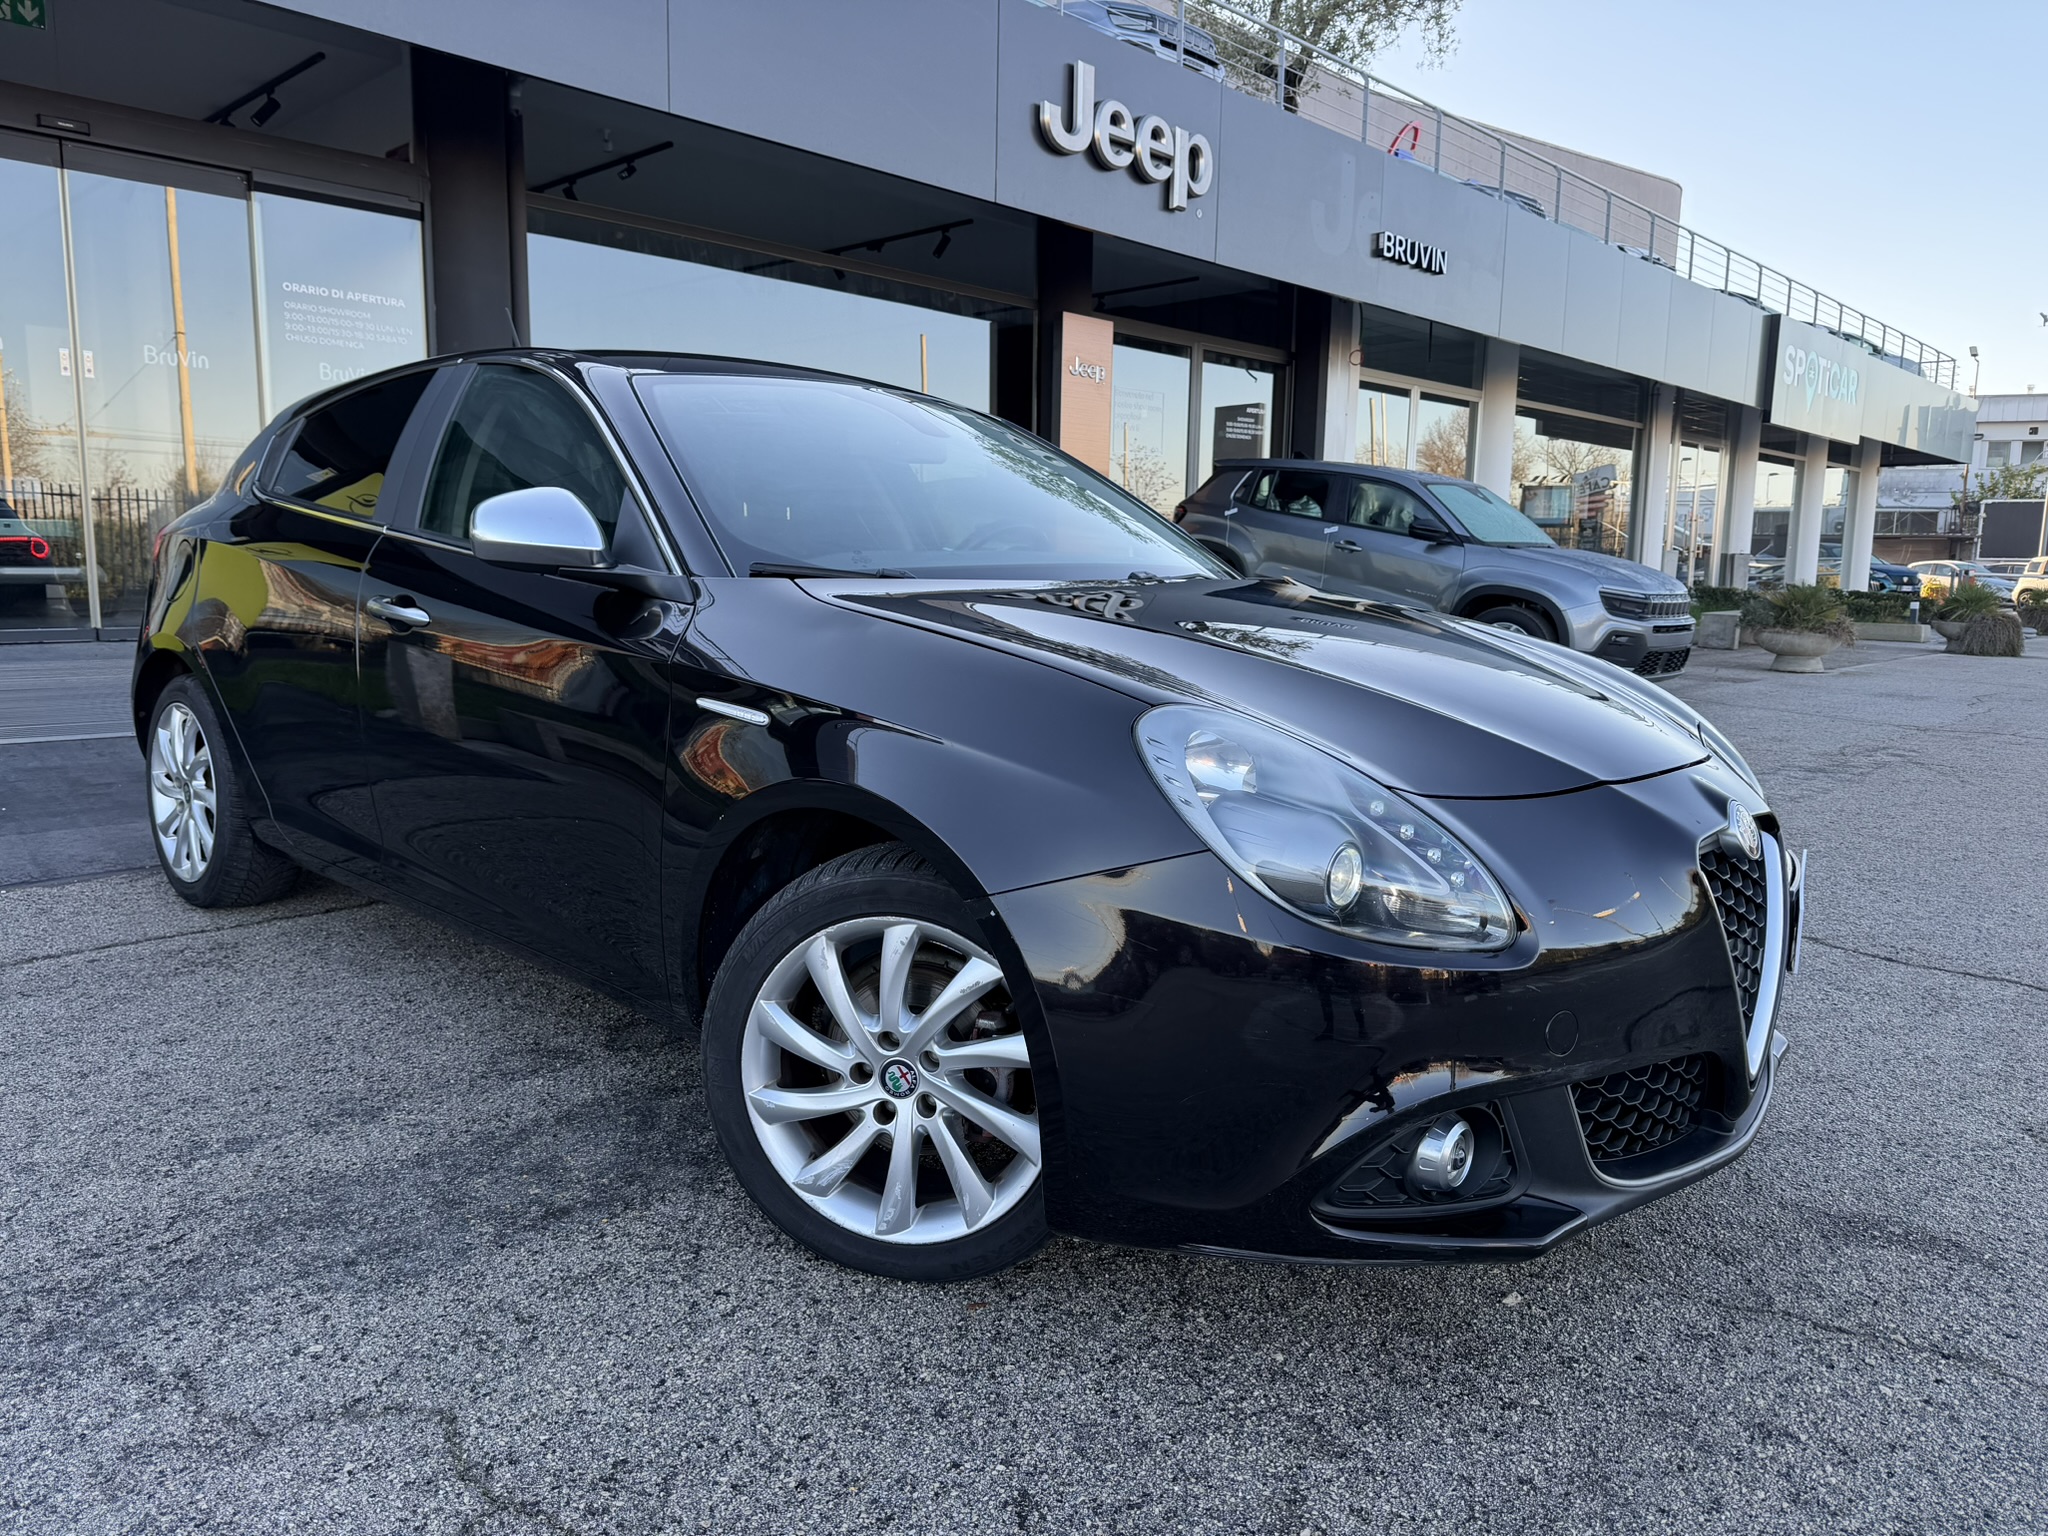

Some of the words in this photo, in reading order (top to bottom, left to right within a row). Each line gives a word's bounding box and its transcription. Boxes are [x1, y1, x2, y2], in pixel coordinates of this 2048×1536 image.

[1039, 59, 1214, 212] Jeep
[1382, 230, 1448, 275] BRUVIN
[282, 281, 329, 297] ORARIO
[331, 288, 344, 299] DI
[346, 291, 406, 308] APERTURA
[283, 300, 317, 313] ORARIO
[318, 305, 371, 319] SHOWROOM
[285, 332, 318, 344] CHIUSO
[319, 336, 365, 350] DOMENICA
[1068, 355, 1107, 385] Jeep
[884, 1085, 911, 1097] ROMEO
